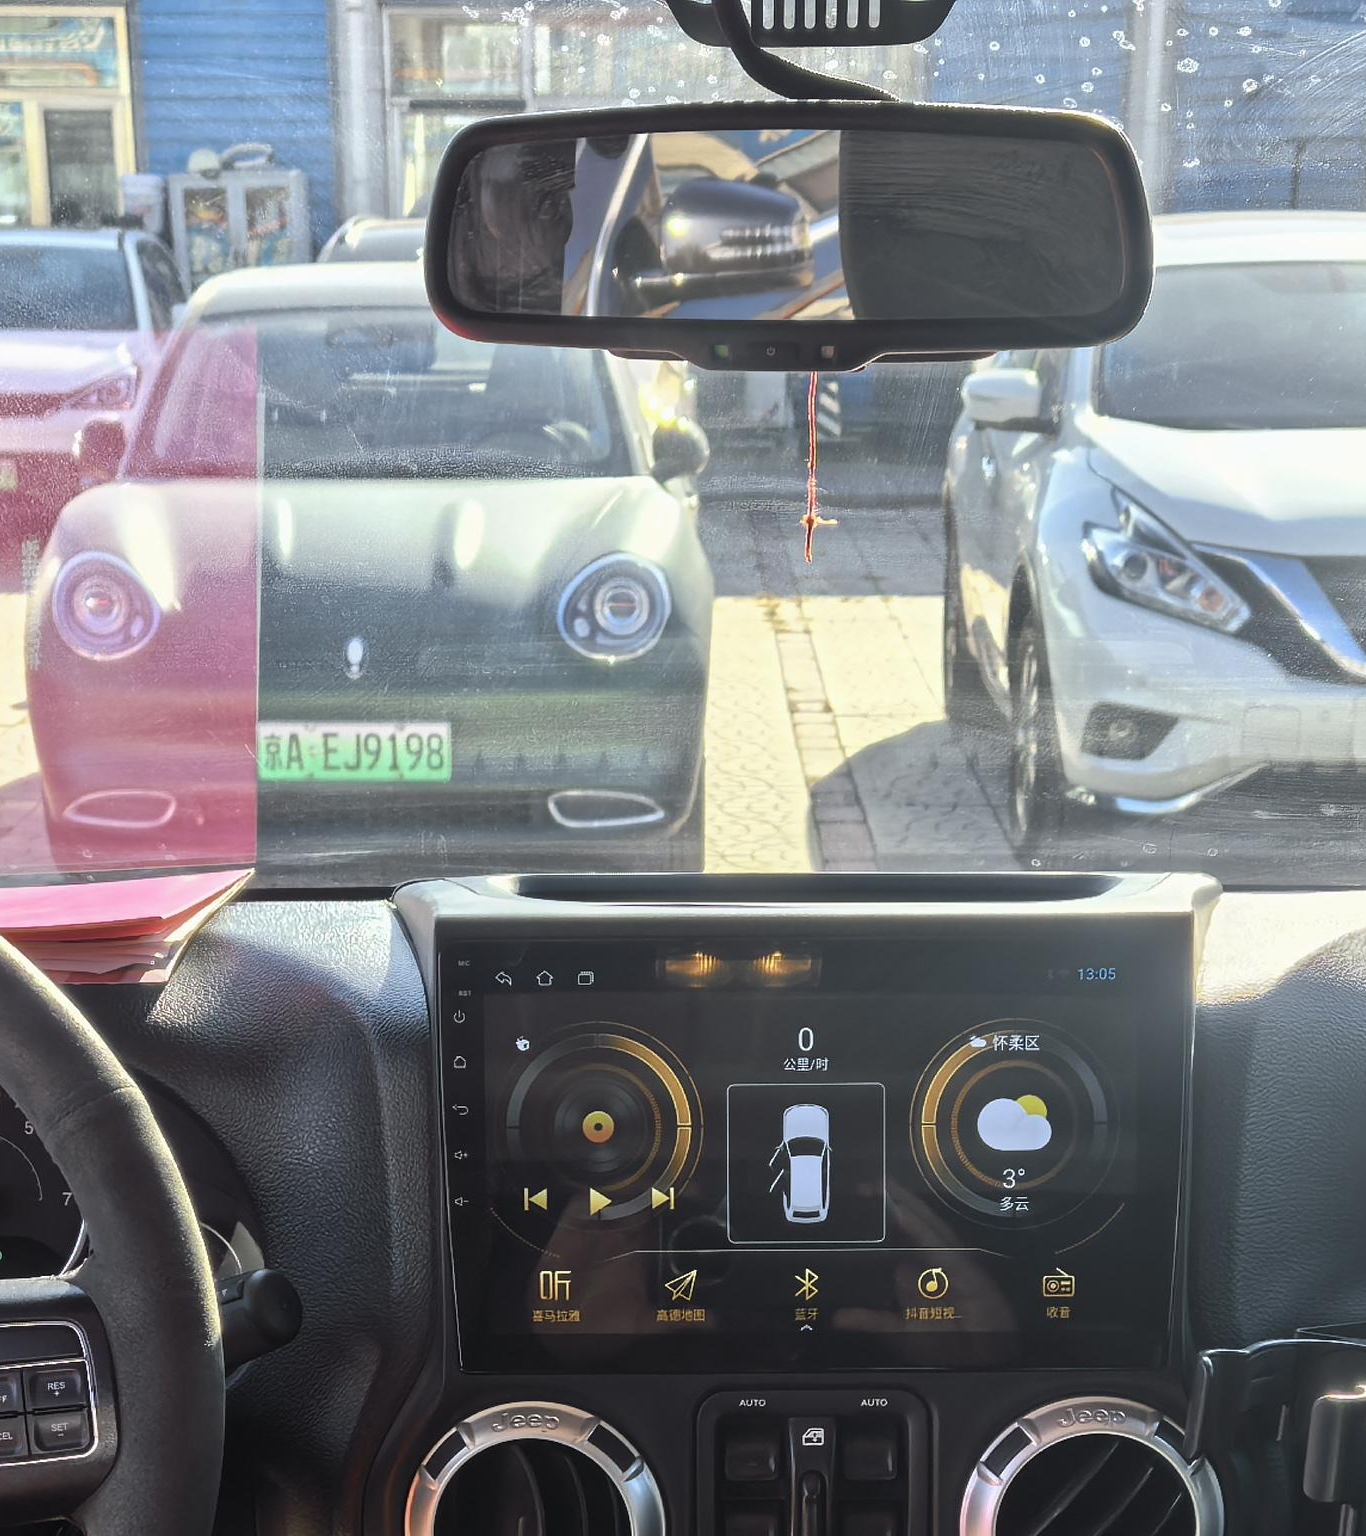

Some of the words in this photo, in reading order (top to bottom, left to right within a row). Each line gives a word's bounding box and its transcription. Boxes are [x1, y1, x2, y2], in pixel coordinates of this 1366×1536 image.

[1078, 967, 1116, 981] 13:05
[798, 1027, 814, 1051] 0
[993, 1034, 1040, 1051] 怀柔区
[783, 1057, 829, 1071] 公里/时
[24, 1121, 34, 1135] 5
[1003, 1168, 1025, 1189] 3°
[62, 1192, 73, 1206] 7
[1000, 1196, 1030, 1211] 多云
[532, 1310, 581, 1323] 喜马拉雅
[656, 1309, 706, 1322] 高德地图
[795, 1308, 819, 1321] 蓝牙
[1046, 1306, 1071, 1319] 收音
[47, 1382, 66, 1391] RES
[738, 1399, 767, 1407] AUTO
[860, 1398, 889, 1407] AUTO
[491, 1411, 560, 1433] Jeep
[1057, 1406, 1126, 1428] Jeep
[50, 1423, 69, 1432] SET
